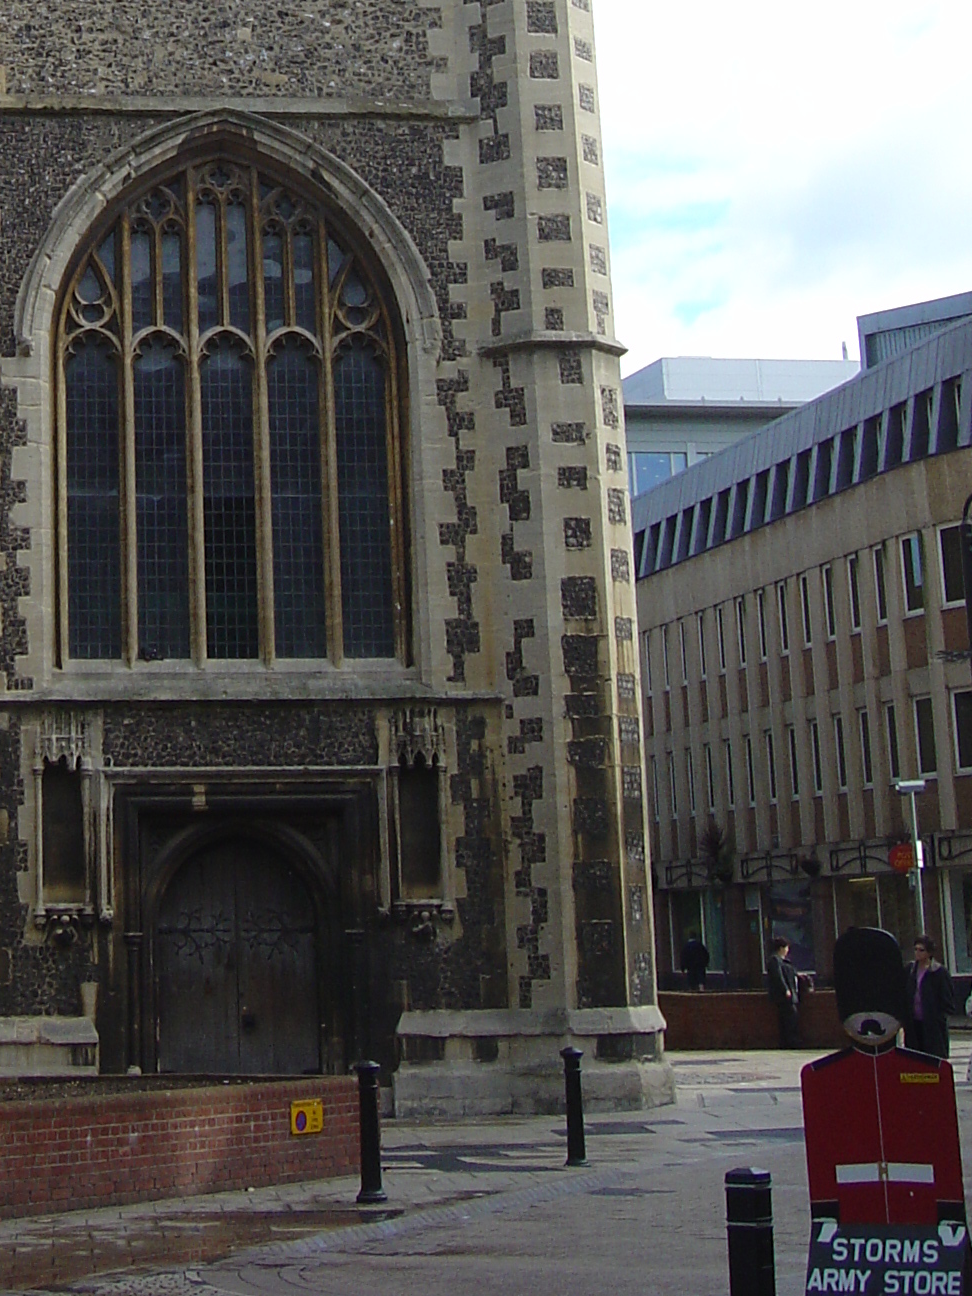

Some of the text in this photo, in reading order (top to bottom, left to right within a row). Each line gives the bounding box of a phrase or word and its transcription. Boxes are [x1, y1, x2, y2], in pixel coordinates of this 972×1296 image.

[832, 1237, 939, 1264] STORMS
[807, 1267, 962, 1296] ARMY STORE
